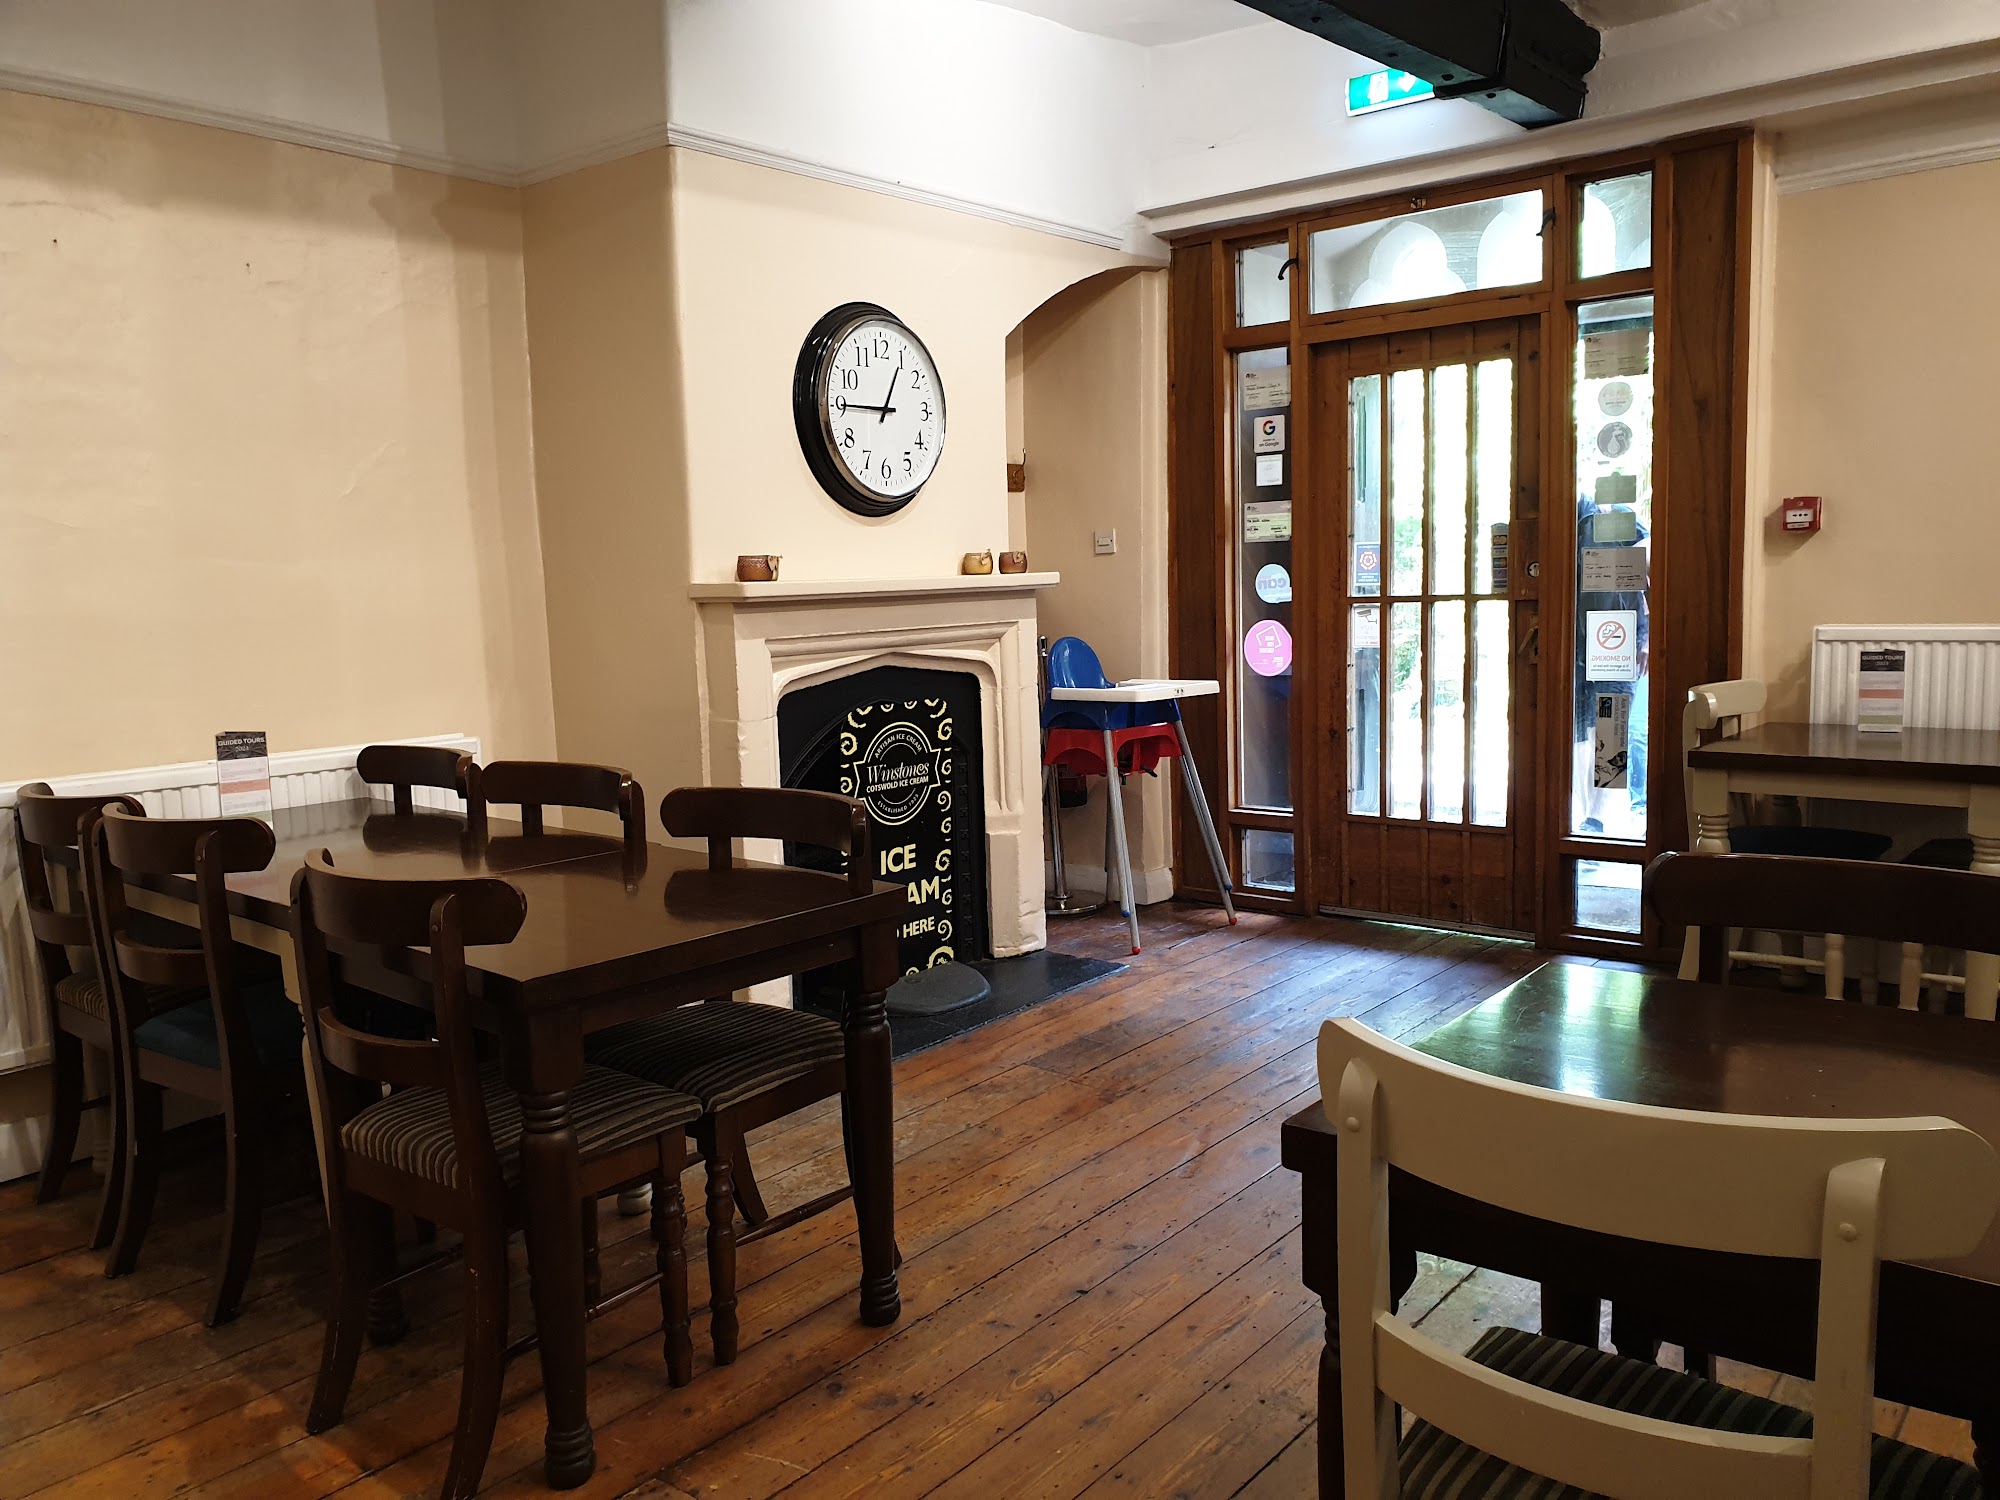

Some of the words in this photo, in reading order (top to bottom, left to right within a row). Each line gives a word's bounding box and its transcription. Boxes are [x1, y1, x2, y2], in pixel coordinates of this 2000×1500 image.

[855, 346, 870, 368] 11
[873, 338, 890, 360] 12
[898, 350, 905, 370] 1
[840, 368, 859, 391] 10
[911, 370, 921, 390] 2
[835, 395, 847, 419] 9
[920, 401, 929, 422] 3
[844, 427, 855, 449] 8
[914, 429, 924, 450] 4
[862, 449, 872, 470] 7
[881, 458, 892, 480] 6
[902, 451, 912, 472] 5
[217, 738, 243, 747] GUIDED
[243, 736, 265, 744] TOURS
[874, 735, 896, 759] ARTISAN
[906, 735, 923, 753] CREAM
[866, 762, 930, 784] Winstones
[866, 781, 898, 793] COTSWOLD
[899, 779, 909, 788] ICE
[909, 775, 929, 786] CREAM
[877, 800, 908, 814] ESTABLISHED
[880, 843, 917, 876] ICE
[902, 915, 936, 939] HERE
